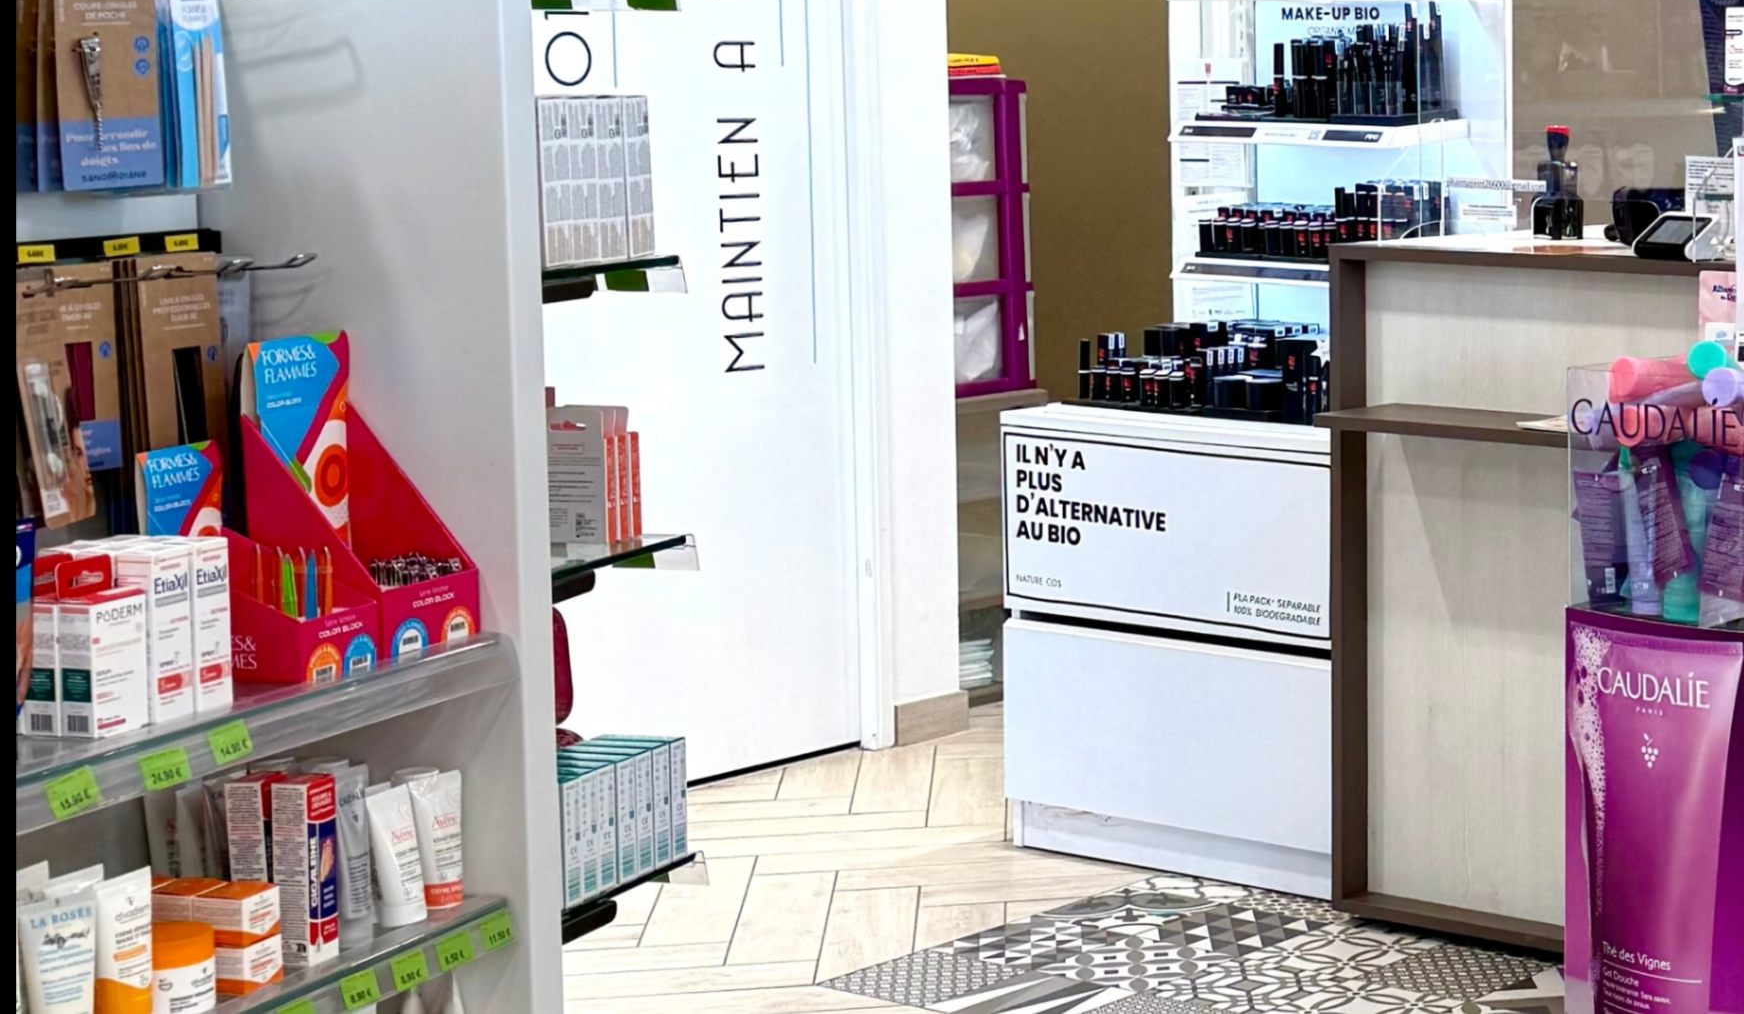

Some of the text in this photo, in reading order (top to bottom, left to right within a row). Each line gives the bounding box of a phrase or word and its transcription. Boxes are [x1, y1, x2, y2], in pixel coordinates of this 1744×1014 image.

[1281, 6, 1380, 21] MAKE-UP BIO
[713, 40, 756, 71] A
[716, 117, 764, 373] MAINTIEN
[264, 362, 318, 384] FLAMMES
[1016, 443, 1086, 470] IL N'Y A
[151, 467, 200, 489] FLAMMES
[1016, 469, 1063, 492] PLUS
[1016, 492, 1166, 532] D'ALTERNATIVE
[1016, 520, 1081, 546] AU BIO
[1016, 574, 1043, 586] NATURE
[1234, 604, 1321, 626] 100% BIODEGRADABLE
[1277, 598, 1321, 613] SEPARABLE
[1597, 666, 1711, 709] CAUDALÍE
[1635, 705, 1664, 716] PARIS
[30, 917, 47, 929] LA
[1602, 940, 1672, 971] Thé des Vignes
[1613, 970, 1640, 987] Douche
